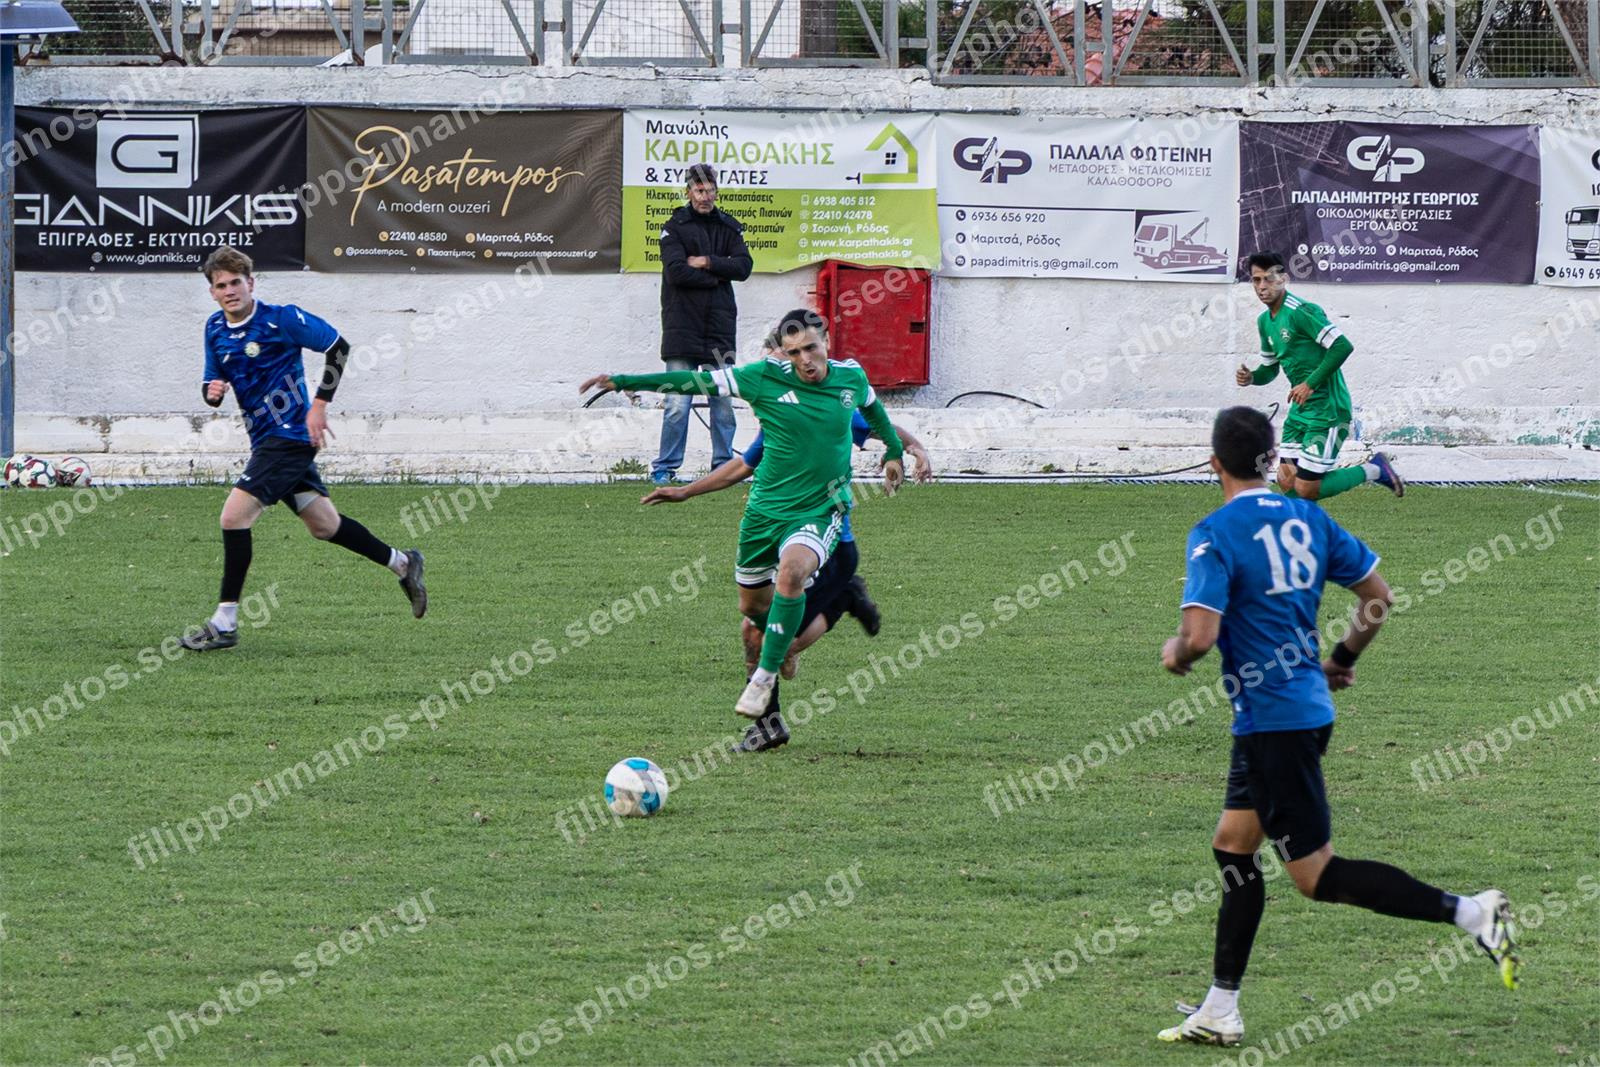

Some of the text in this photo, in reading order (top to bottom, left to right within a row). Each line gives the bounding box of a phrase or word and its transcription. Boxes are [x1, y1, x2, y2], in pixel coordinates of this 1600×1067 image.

[646, 119, 729, 139] Μανώλης
[645, 139, 835, 165] ΚΑΡΠΑΘΑΚΗΣ
[1130, 146, 1212, 162] ΦΩΤΕΙΝΗ
[351, 125, 584, 226] Pasatempos
[645, 167, 768, 185] & ΣΥΓΑΤΕΣ
[1049, 164, 1117, 174] ΜΕΤΑΦΟΡΕΣ
[1129, 165, 1212, 177] ΜΕΤΑΚΟΜΙΣΕΙΣ
[1087, 177, 1173, 187] ΚΑΛΑΘΟΦΟΡΟ
[717, 191, 774, 204] γκαταστάσεις
[813, 196, 837, 206] 6938
[1291, 191, 1479, 205] ΠΑΠΑΔΗΜΗΤΡΗΣ ΓΕΩΡΓΙΟΣ
[377, 200, 491, 214] A modern ouzeri
[812, 210, 841, 220] 22410
[971, 212, 1046, 223] 6936 656 920
[1316, 208, 1452, 220] ΟΙΚΟΔΟΜΙΚΕΣ ΕΡΓΑΣΙΕΣ
[856, 224, 889, 234] Ρόδος
[1350, 221, 1418, 231] ΕΡΓΟΛΑΒΟΣ
[38, 231, 134, 247] ΕΠΙΓΡΑΦΕΣ
[148, 232, 254, 247] ΕΚΤΥΠΩΣΕΙΣ
[389, 231, 447, 242] 22410 48580
[476, 233, 553, 244] Μαριτσά, Ρόδος
[971, 234, 1061, 246] Μαριτσά, Ρόδος
[1312, 246, 1376, 255] 6936 656 920
[1400, 246, 1479, 258] Μαριτσά, Ρόδος
[106, 252, 201, 265] www.giannikis.eu
[970, 257, 1119, 270] papadimitris.g@gmail.com
[1330, 260, 1459, 272] papadimitris.g@gmail.com
[1559, 267, 1584, 279] 6949
[1253, 519, 1318, 595] 18
